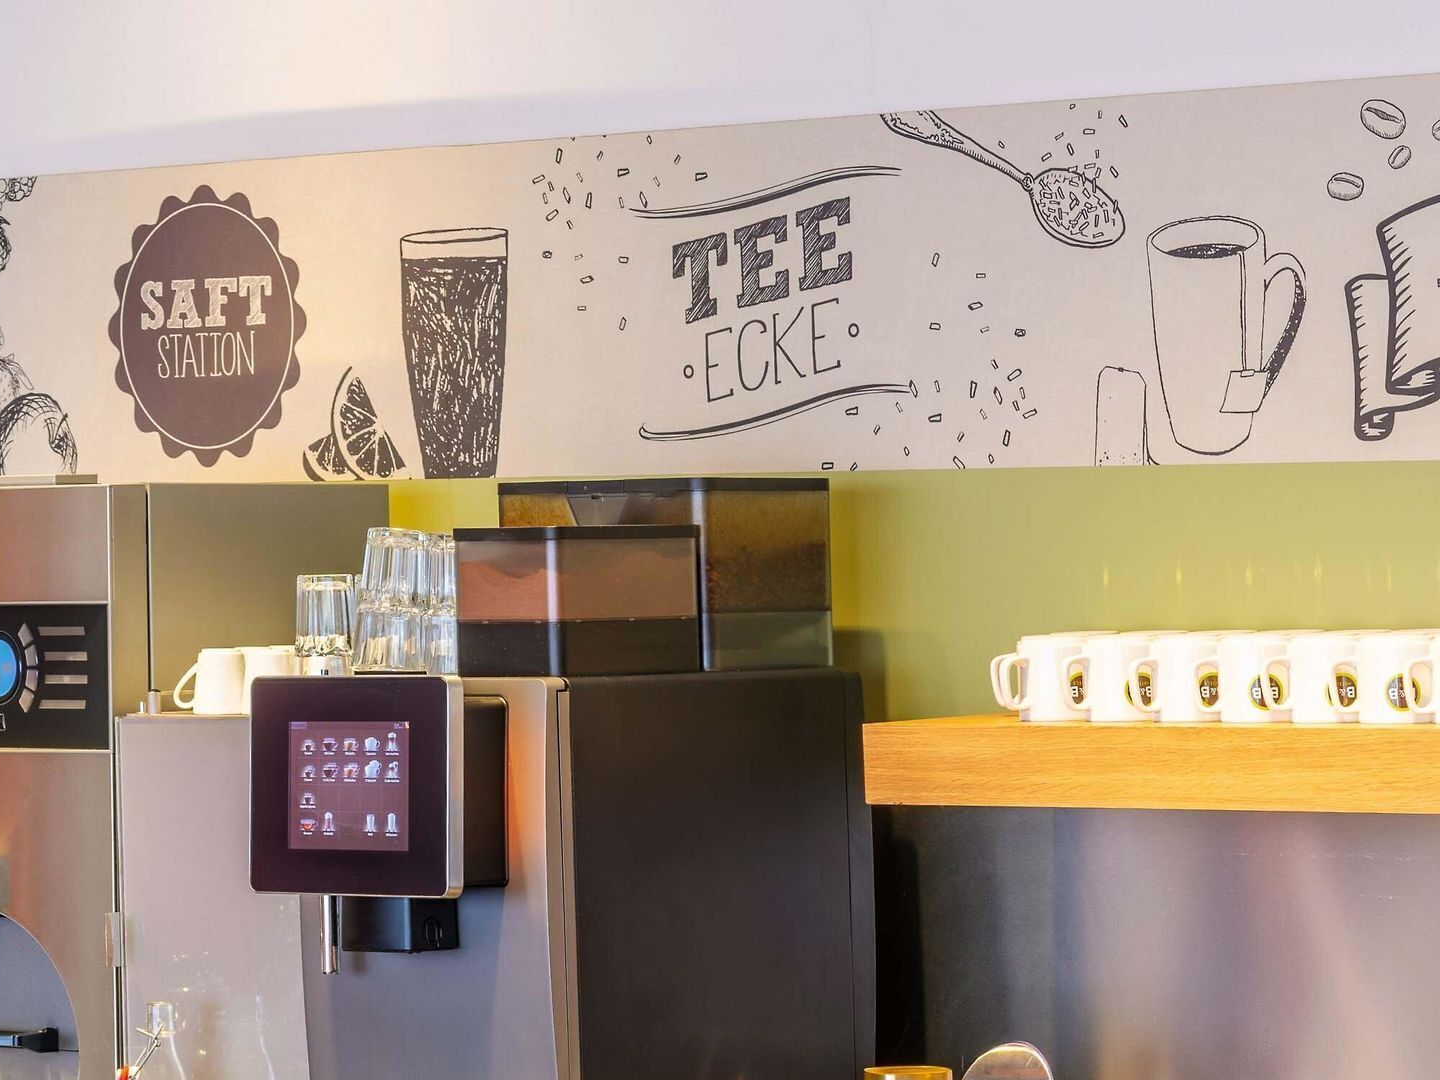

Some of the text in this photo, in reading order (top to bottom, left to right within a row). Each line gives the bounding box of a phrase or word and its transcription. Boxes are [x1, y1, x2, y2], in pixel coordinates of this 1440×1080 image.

[671, 195, 854, 324] TEE
[140, 275, 273, 331] SAFT
[157, 329, 257, 380] STATION
